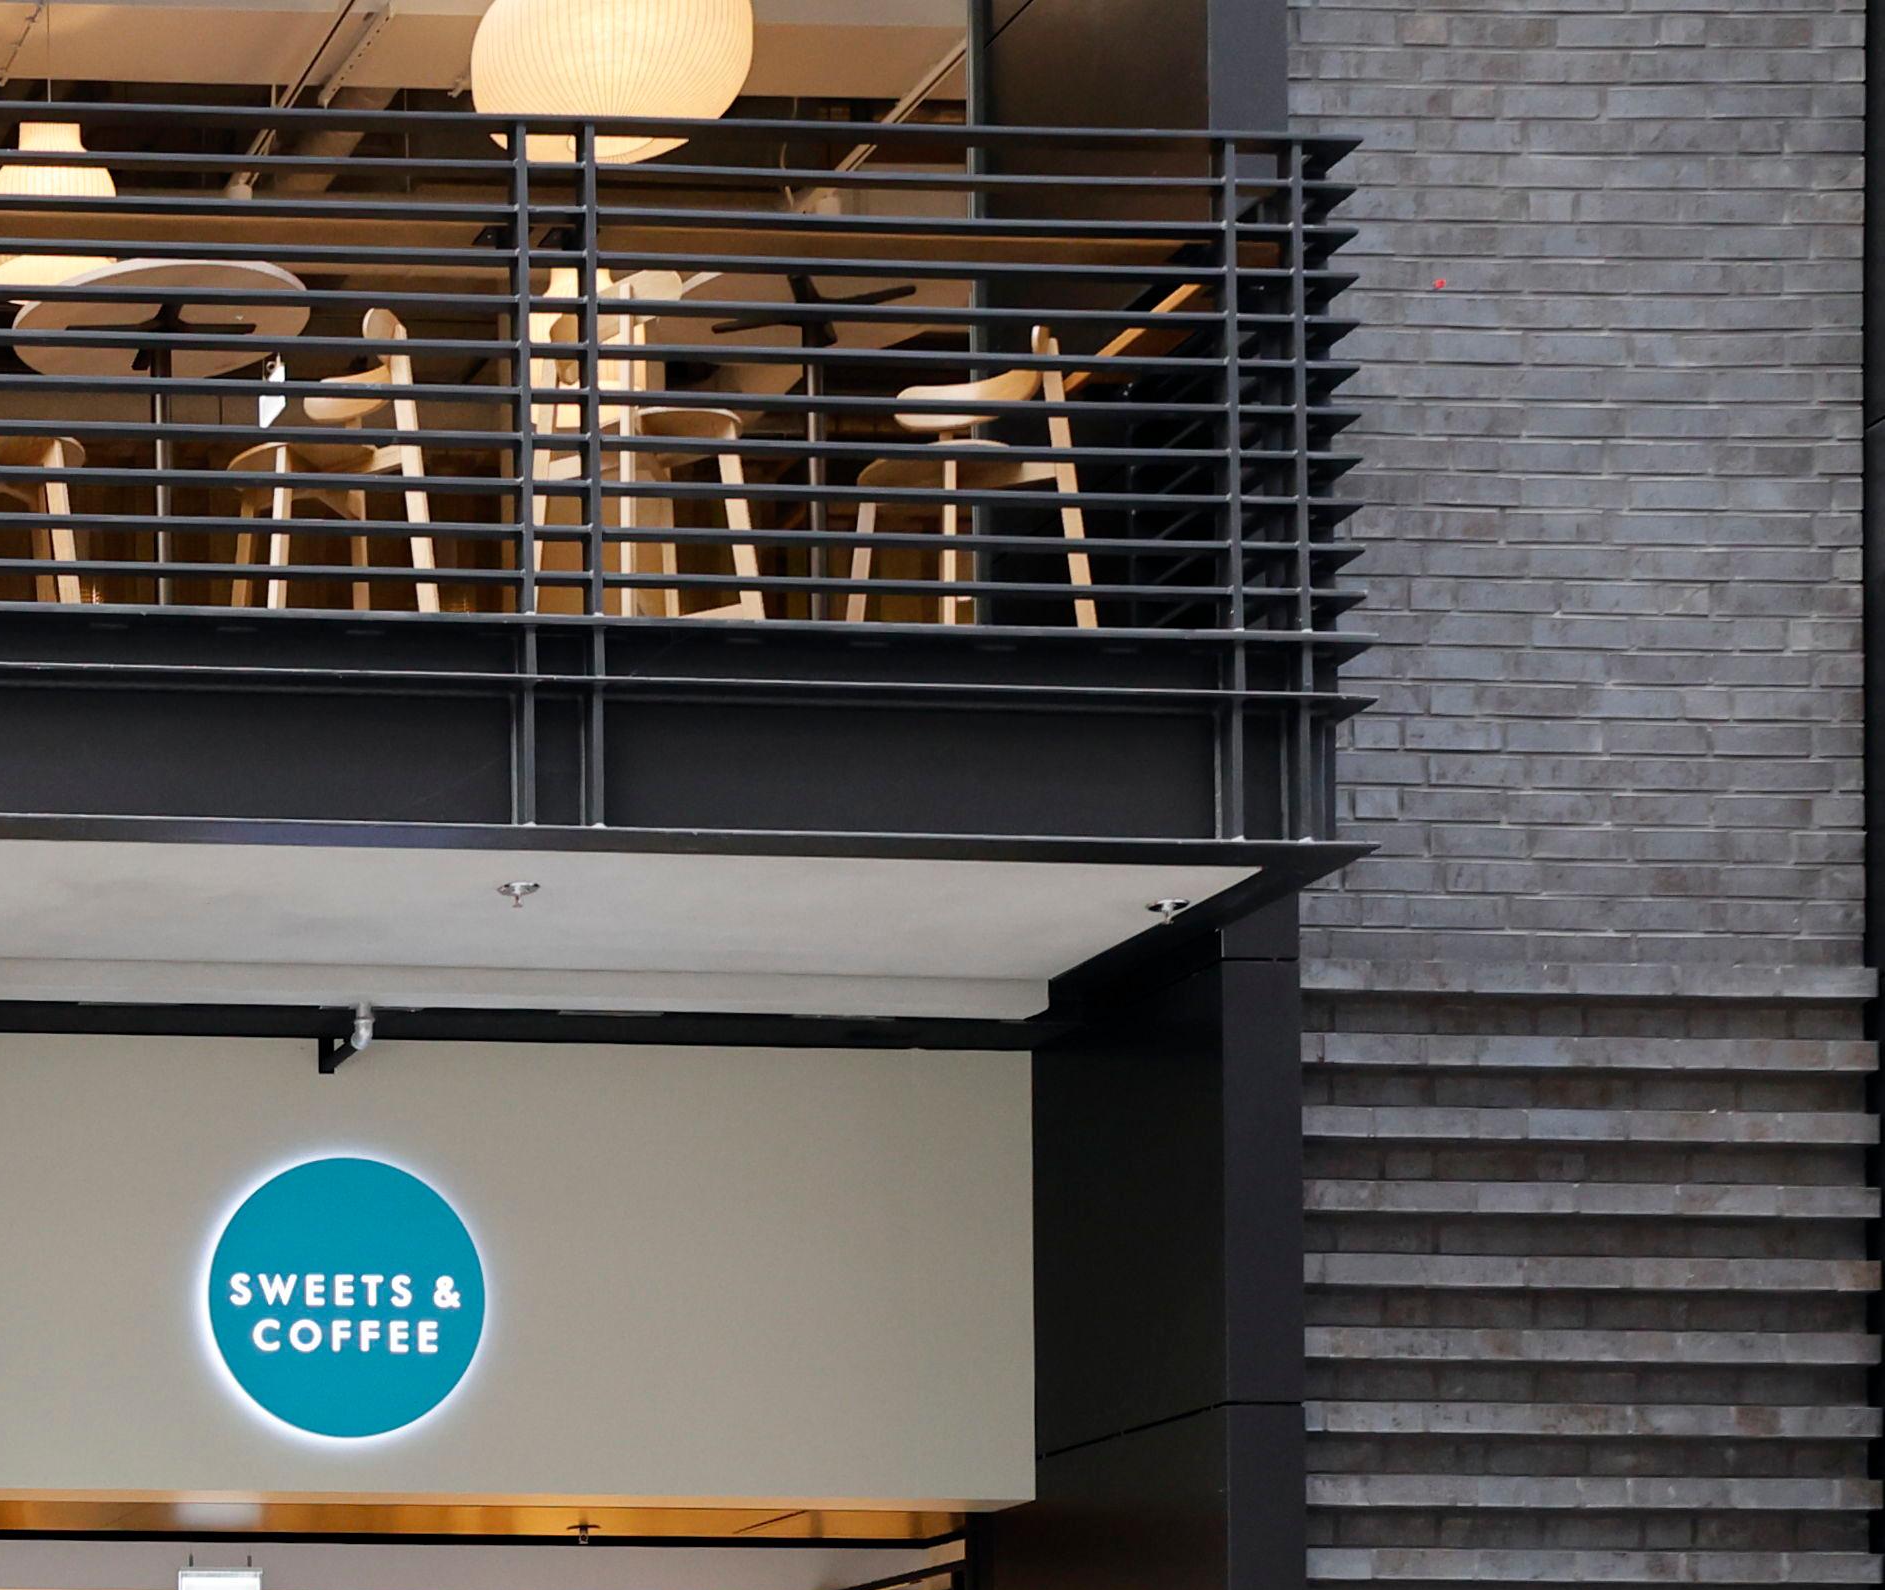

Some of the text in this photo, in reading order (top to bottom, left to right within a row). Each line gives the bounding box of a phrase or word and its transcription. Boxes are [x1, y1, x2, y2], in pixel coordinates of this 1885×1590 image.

[230, 1273, 461, 1309] SWEETS &
[252, 1318, 439, 1354] COFFEE
